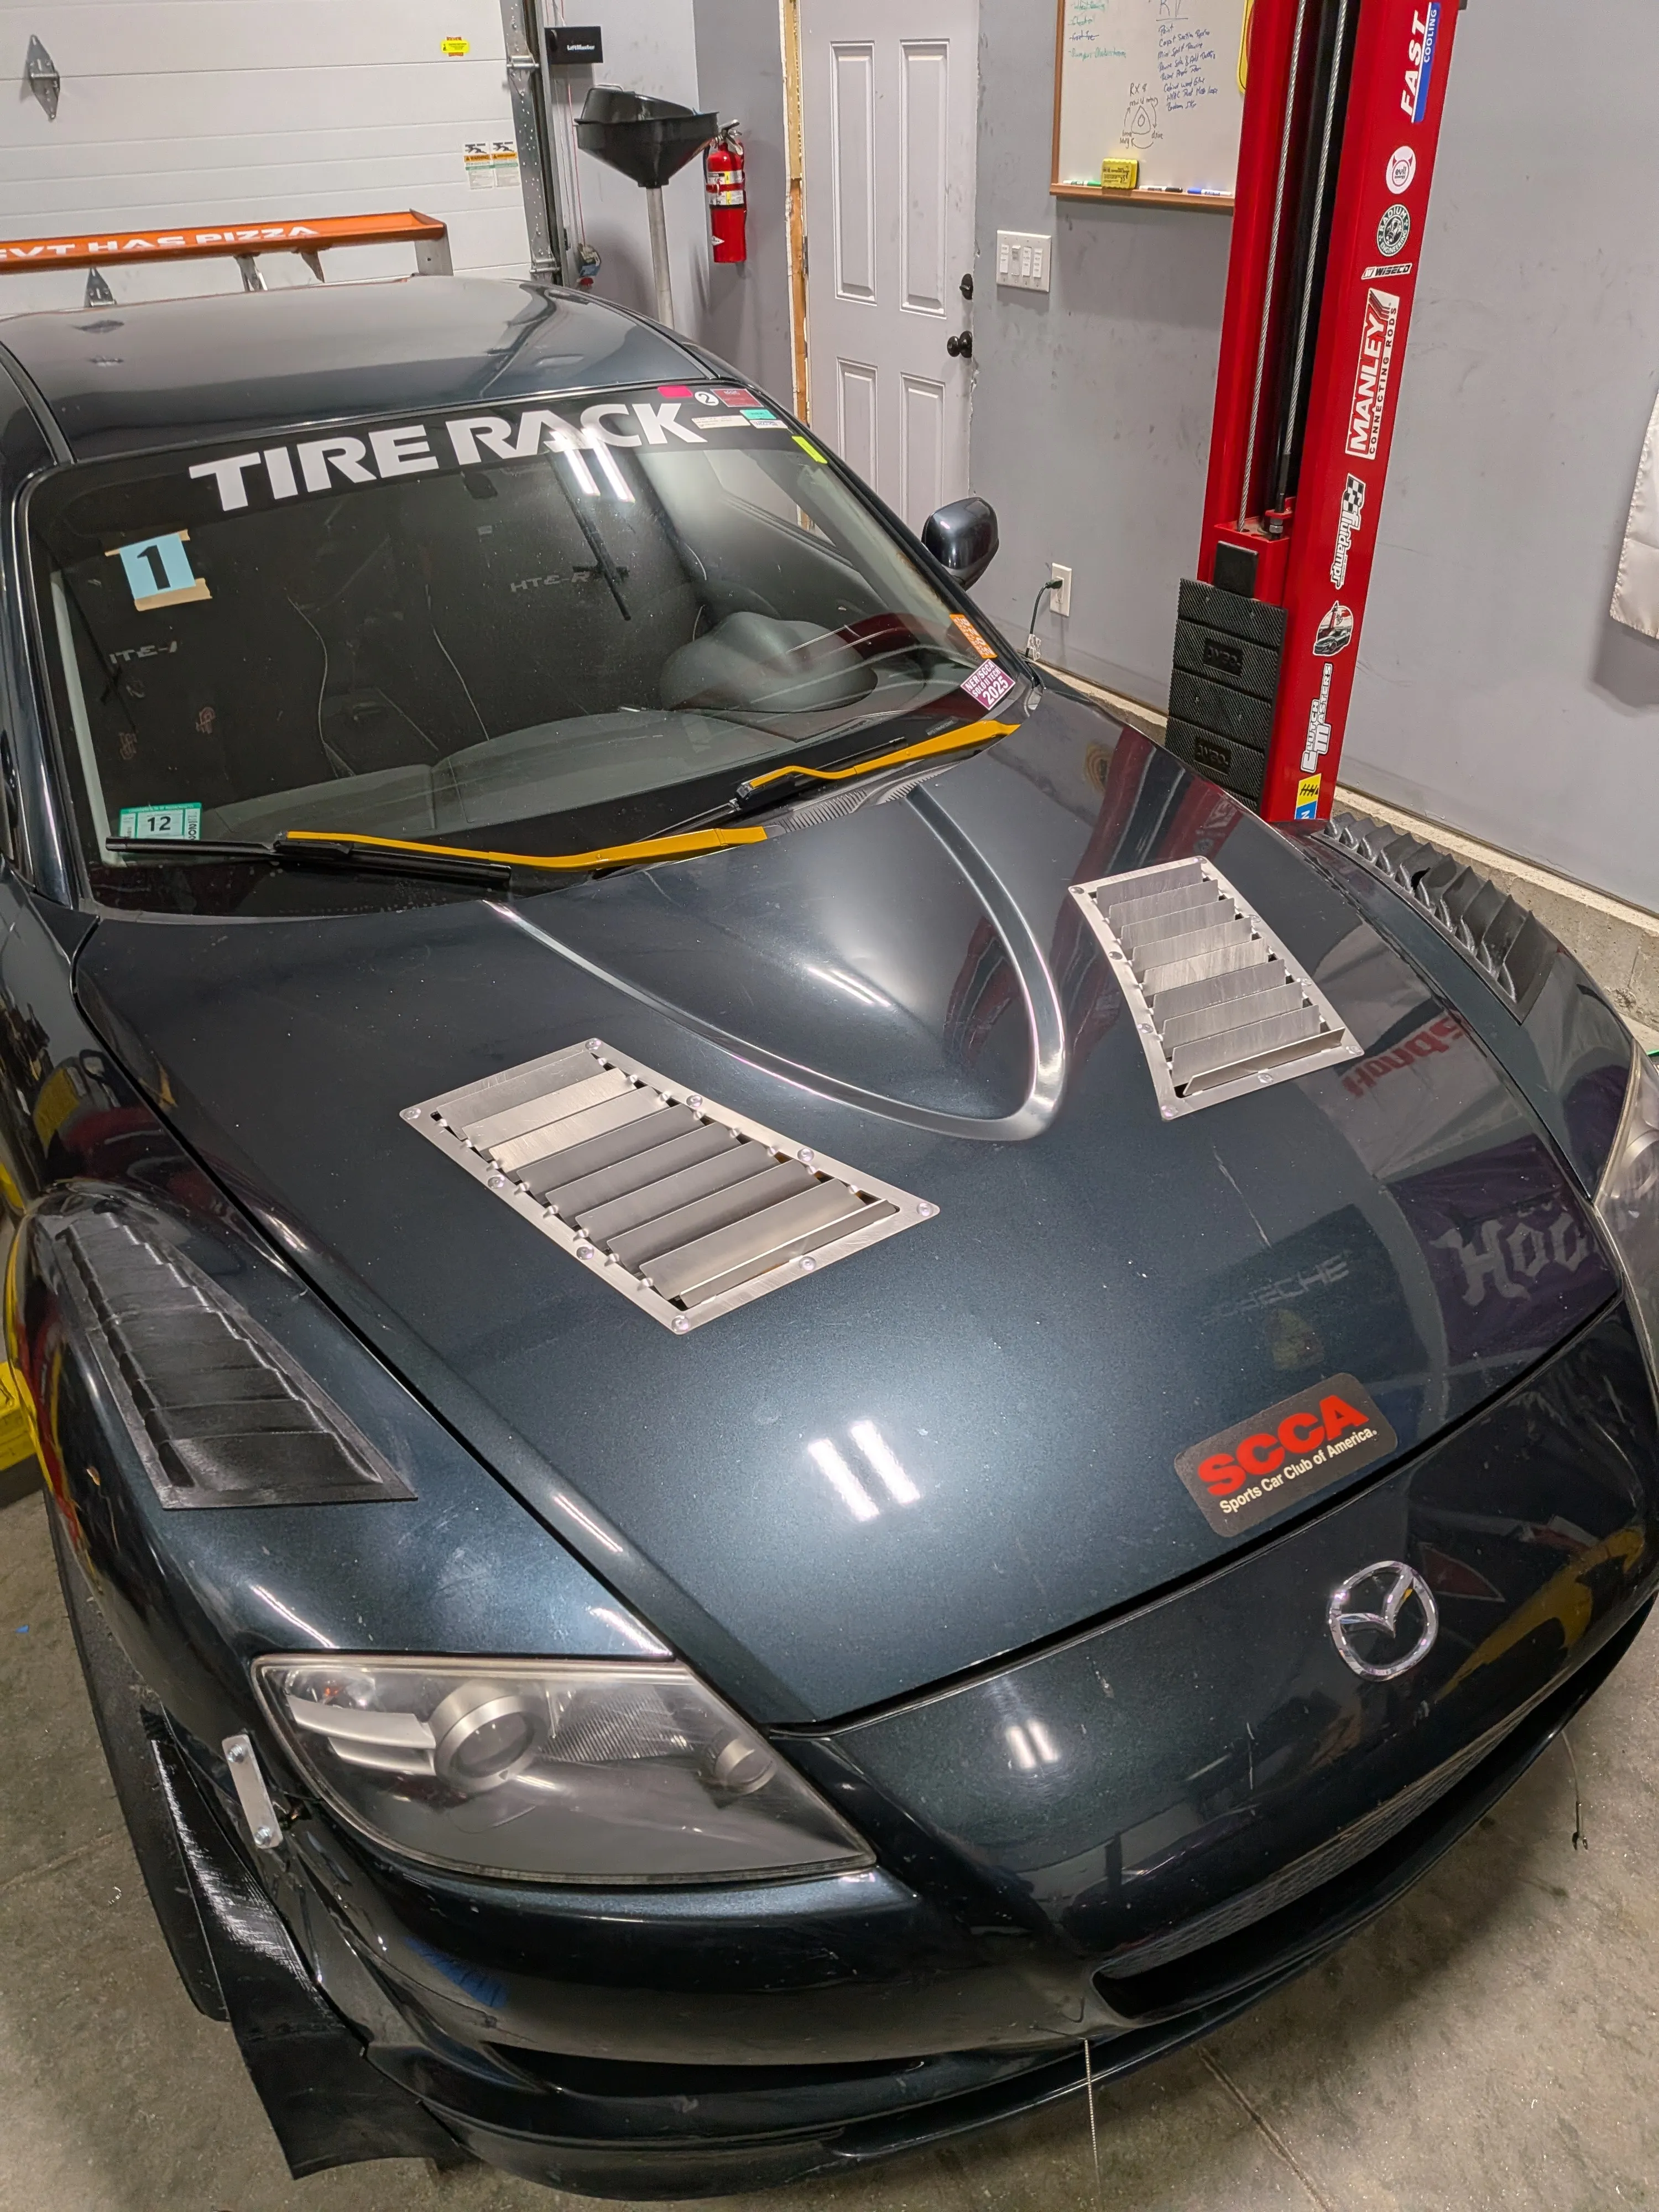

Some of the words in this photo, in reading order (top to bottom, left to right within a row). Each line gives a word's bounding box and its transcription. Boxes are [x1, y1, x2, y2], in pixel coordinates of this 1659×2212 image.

[1423, 9, 1437, 64] COOLING
[1401, 10, 1425, 116] FAST
[1395, 165, 1407, 175] evil
[88, 236, 186, 252] HAS
[196, 226, 320, 246] PIZZA
[1379, 206, 1407, 231] RADIUM
[1380, 229, 1407, 254] ENGINEERING
[1375, 264, 1410, 276] WISECO
[1350, 314, 1385, 450] MANLEY
[1369, 357, 1389, 455] CONNECTING
[1385, 307, 1396, 347] RODS
[189, 424, 439, 512] TIRE
[445, 403, 708, 466] RACK
[137, 545, 171, 590] 1
[1332, 510, 1360, 588] fluidampr
[964, 660, 995, 692] NER/SCCA
[972, 682, 987, 698] SOLO
[988, 667, 1001, 682] TECH
[982, 676, 1009, 706] 2025
[1315, 664, 1332, 753] MASTERS
[1302, 700, 1319, 771] CLUTCH
[147, 816, 172, 832] 12
[1197, 1394, 1369, 1497] SCCA
[1219, 1485, 1263, 1515] Sports
[1260, 1471, 1284, 1493] Car
[1283, 1458, 1314, 1480] Club
[1312, 1448, 1327, 1467] of
[1326, 1428, 1378, 1459] America.
